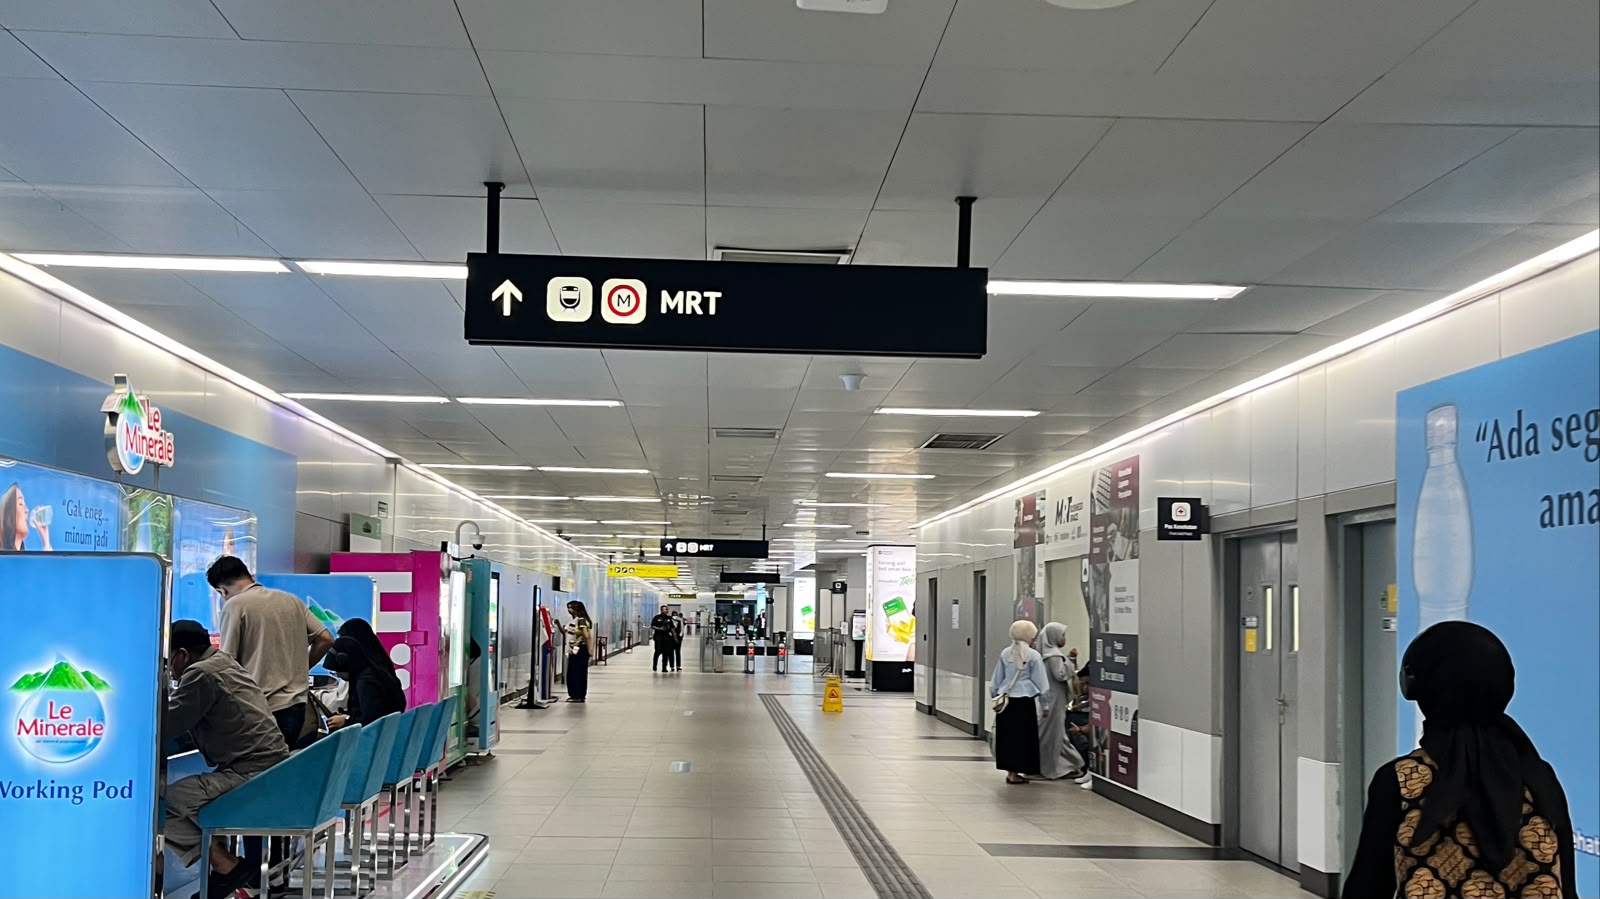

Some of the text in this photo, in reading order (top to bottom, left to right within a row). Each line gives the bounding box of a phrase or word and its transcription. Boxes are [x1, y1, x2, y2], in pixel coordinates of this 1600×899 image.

[660, 289, 722, 315] MRT
[146, 399, 161, 432] Le
[125, 422, 173, 462] Minerale
[1539, 488, 1599, 529] ama
[64, 526, 108, 551] minum jadi
[48, 701, 72, 720] Le
[17, 718, 104, 737] Minerale
[93, 779, 133, 799] Pod
